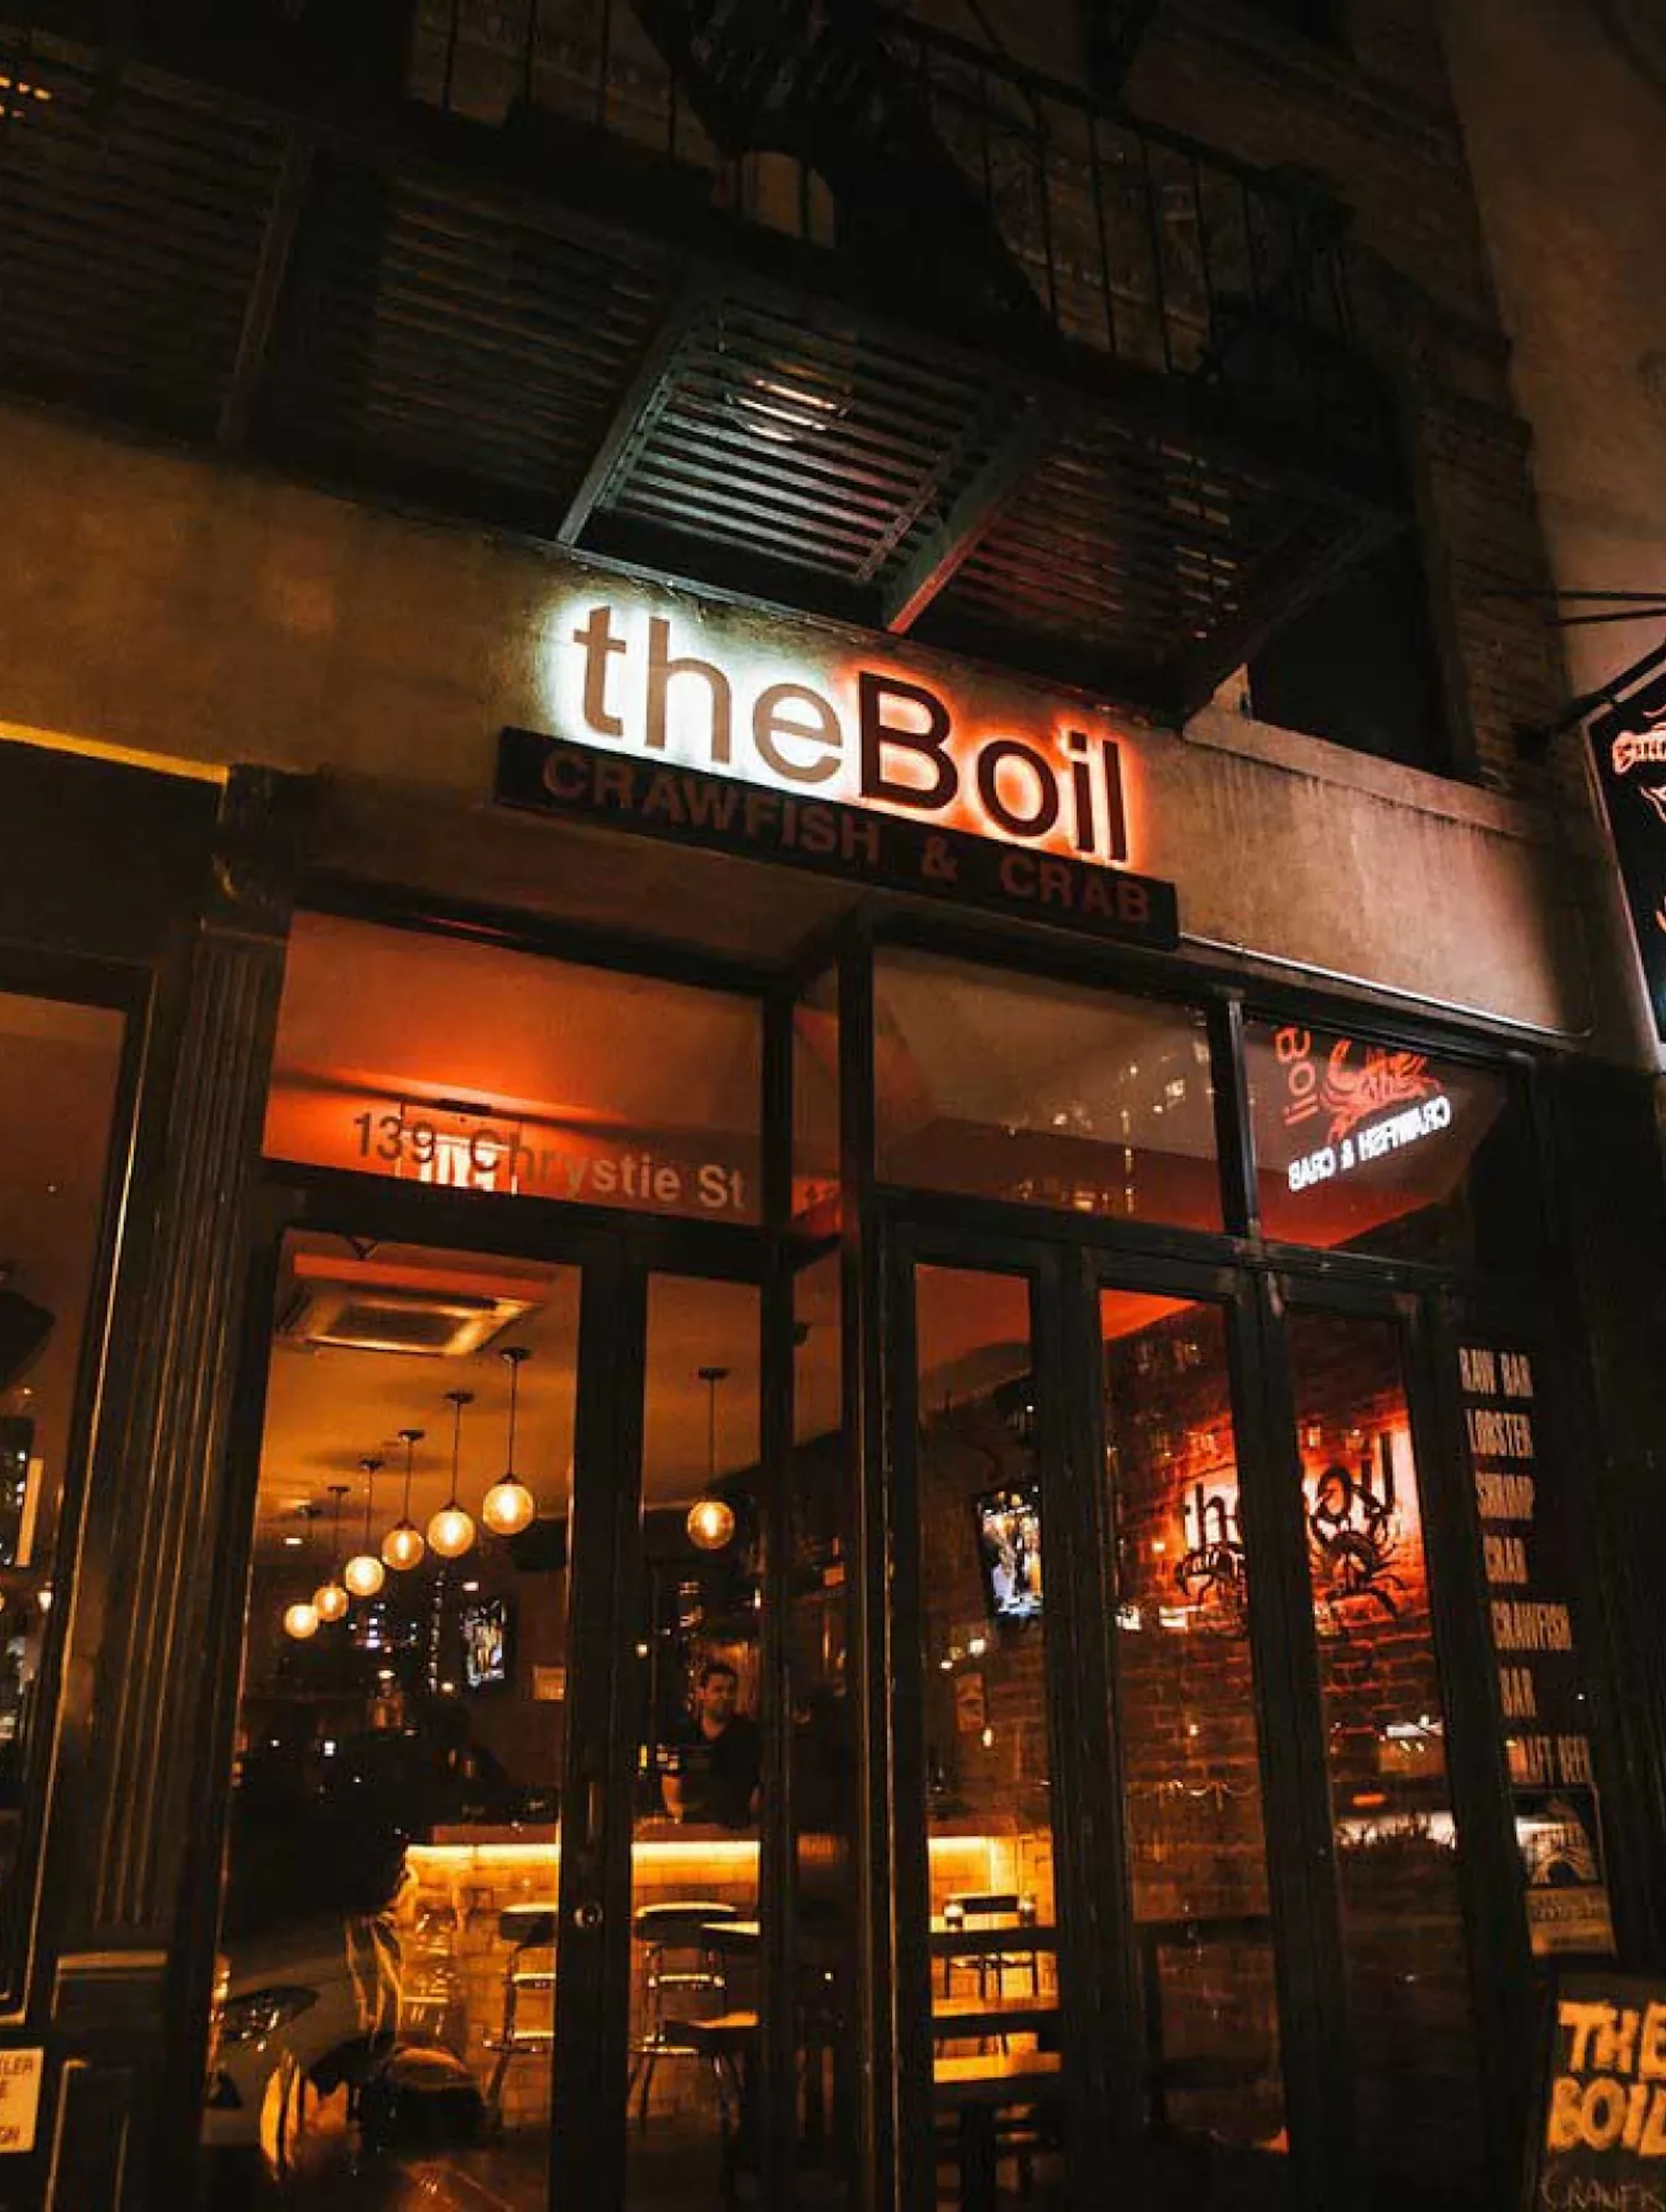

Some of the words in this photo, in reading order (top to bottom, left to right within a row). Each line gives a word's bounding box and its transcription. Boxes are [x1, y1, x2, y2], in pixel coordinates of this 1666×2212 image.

[543, 747, 880, 864] CRAWFISH
[921, 835, 958, 882] &
[1000, 854, 1151, 924] CRAB
[354, 1112, 434, 1163] 139
[469, 1129, 681, 1203] Chrystie
[698, 1164, 746, 1209] St
[1500, 1352, 1533, 1397] BAR
[1466, 1408, 1534, 1458] LOBSTER
[1482, 1534, 1529, 1584] CRAB
[1499, 1666, 1538, 1718] BAR
[1558, 2000, 1666, 2081] THE
[1547, 2076, 1666, 2158] BOIL
